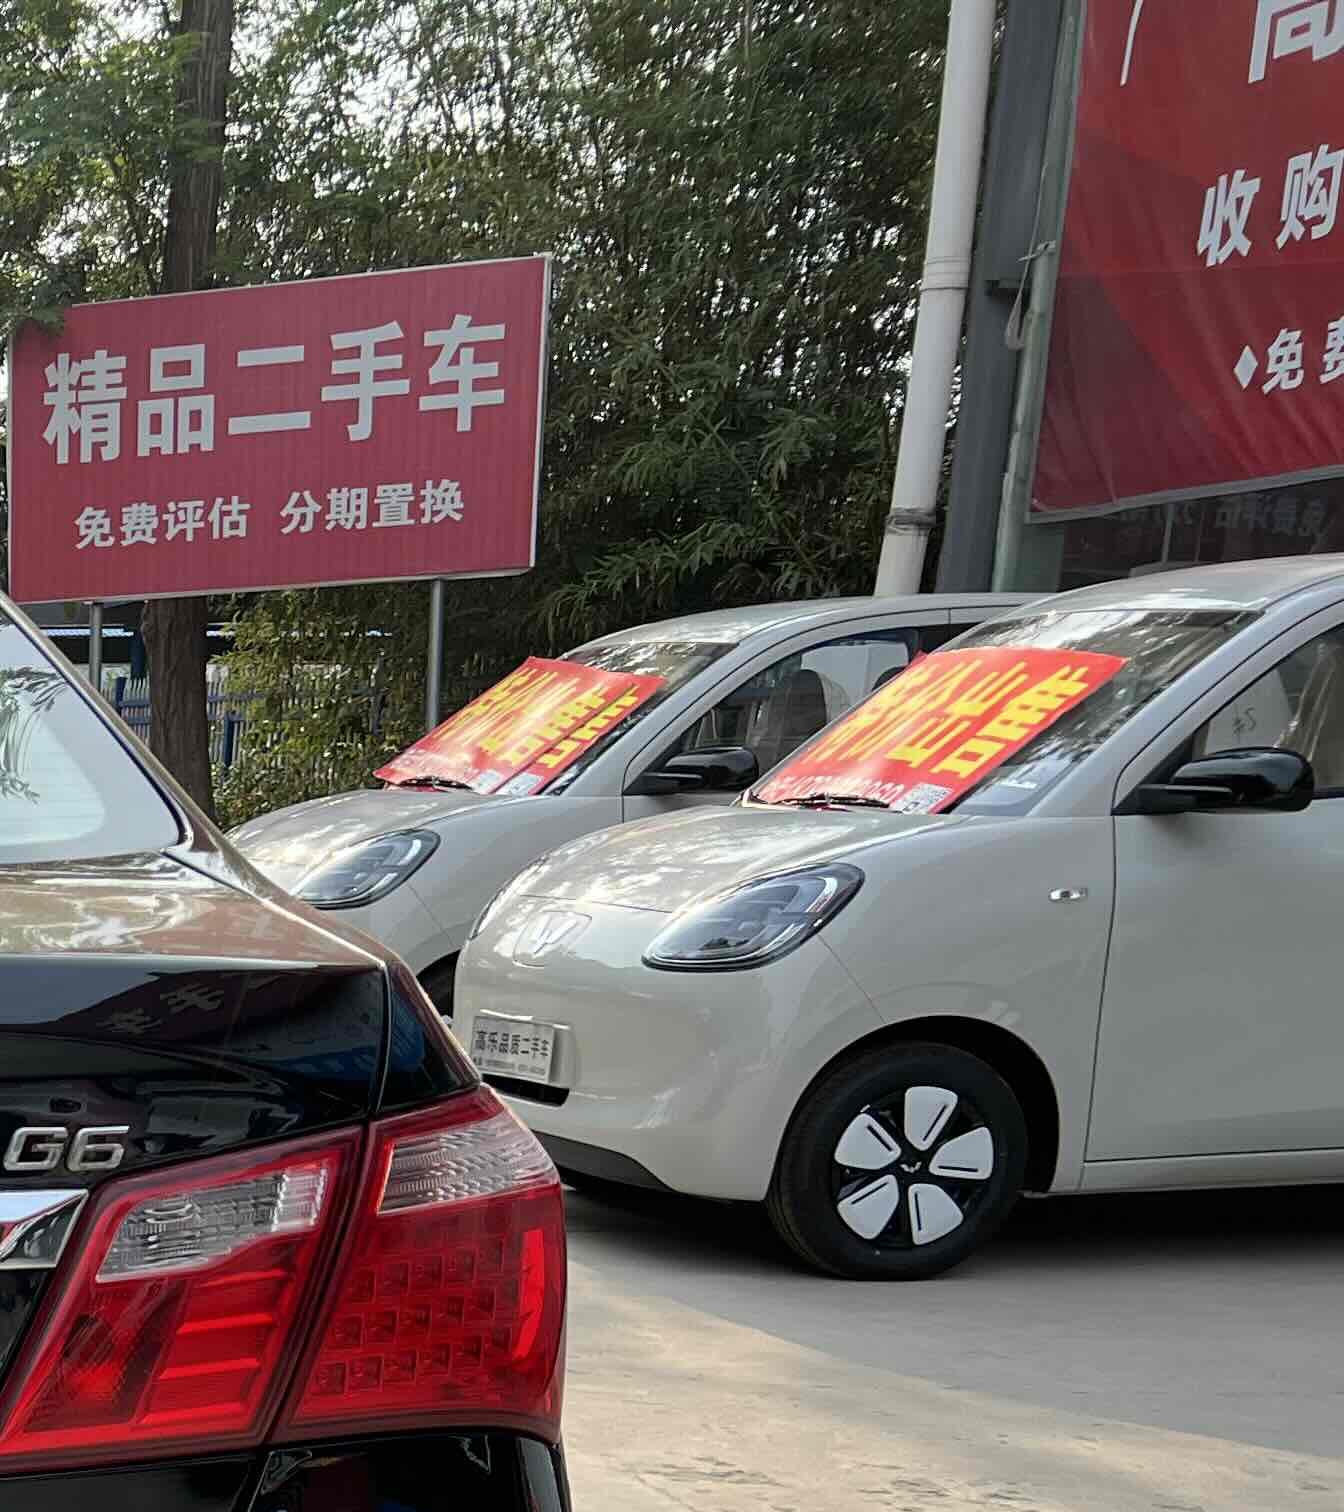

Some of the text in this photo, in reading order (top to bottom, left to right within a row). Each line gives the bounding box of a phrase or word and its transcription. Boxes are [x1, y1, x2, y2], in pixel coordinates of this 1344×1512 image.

[43, 314, 506, 465] 精品二手车
[74, 479, 465, 550] 免费评估 分期置换
[3, 1125, 130, 1171] G6
